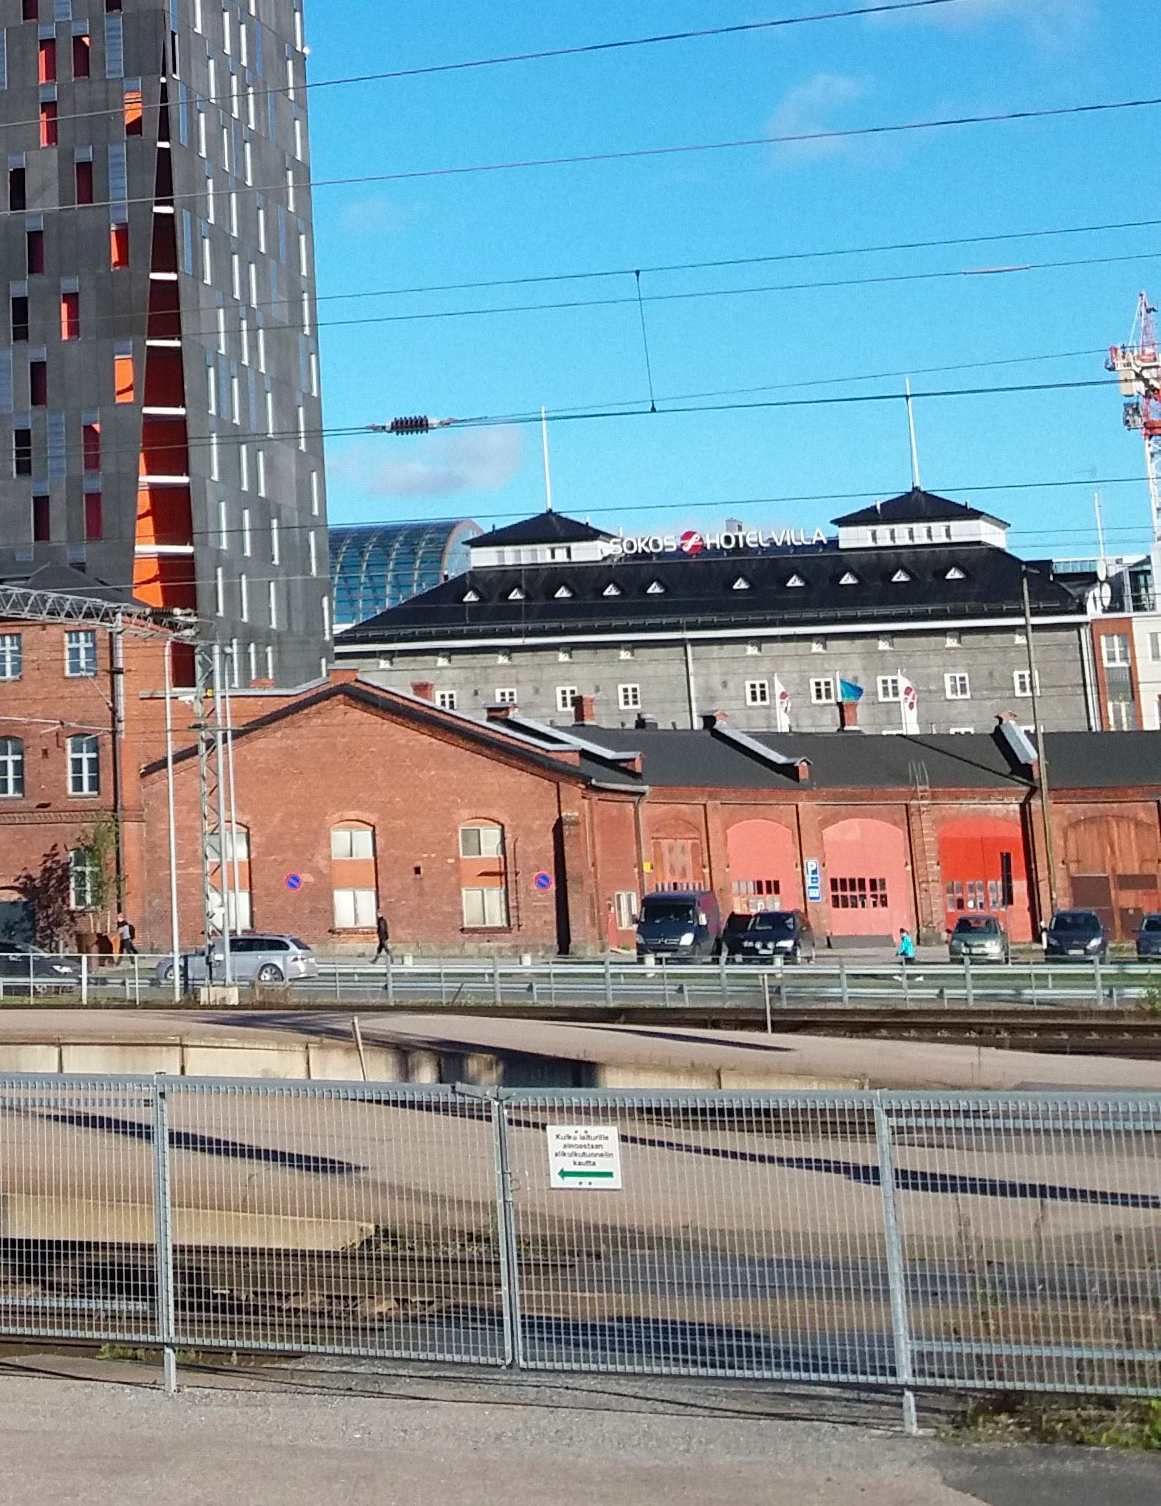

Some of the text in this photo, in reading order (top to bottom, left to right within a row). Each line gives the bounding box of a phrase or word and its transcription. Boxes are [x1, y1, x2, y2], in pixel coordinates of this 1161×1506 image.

[608, 528, 828, 555] SOKOS HOTEL VILLA
[807, 861, 817, 876] P
[555, 1133, 578, 1141] Kulku
